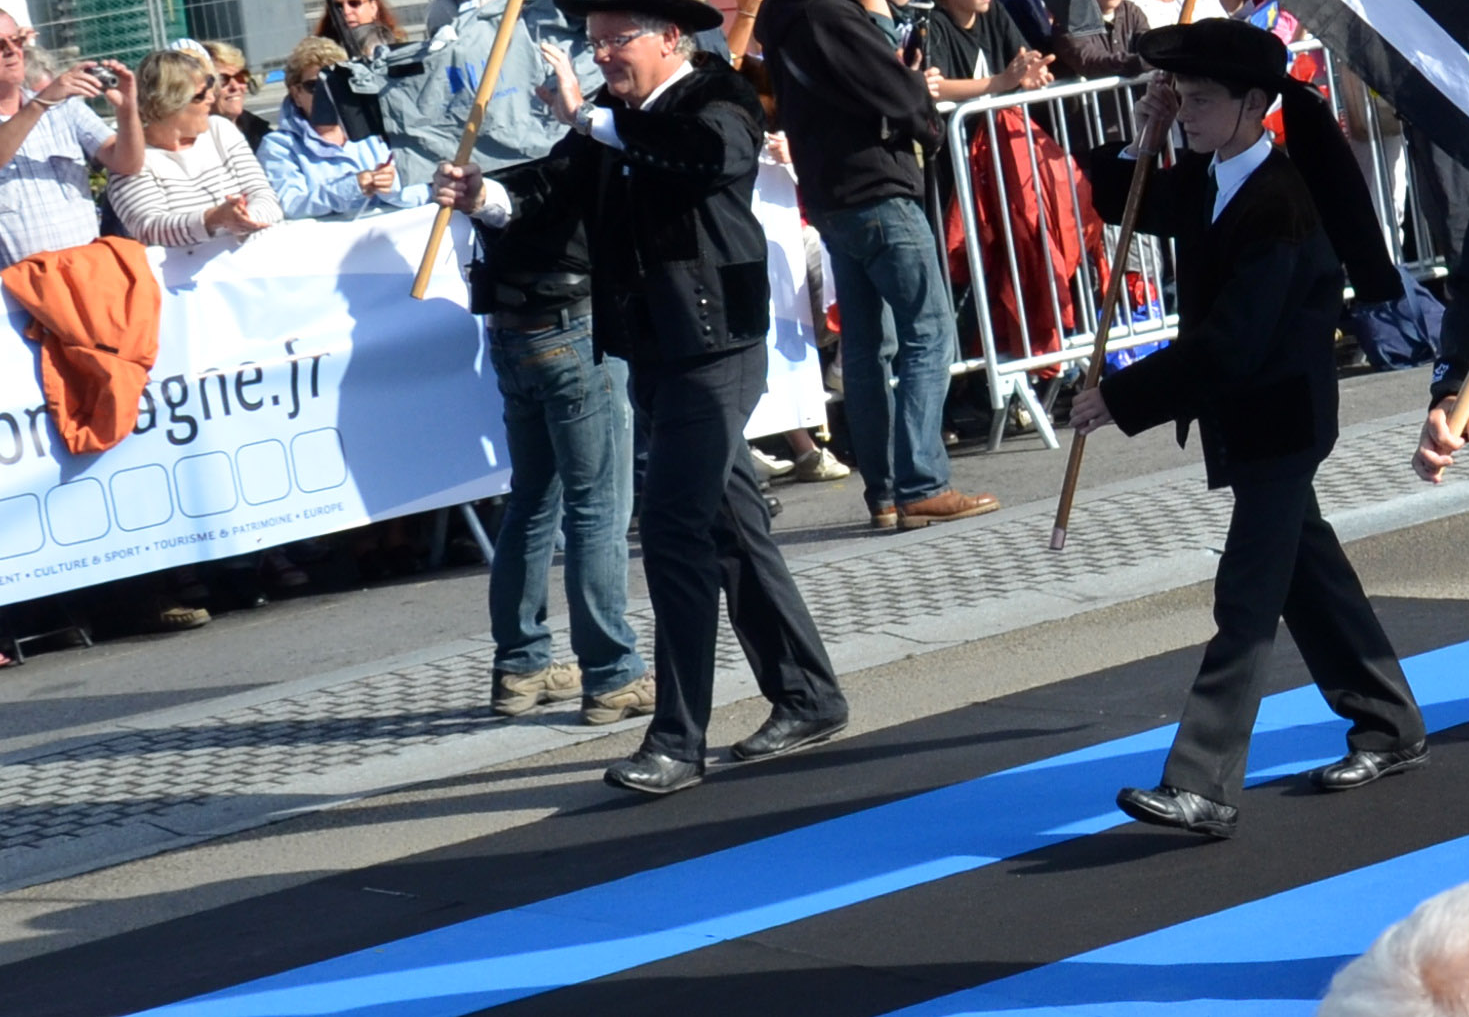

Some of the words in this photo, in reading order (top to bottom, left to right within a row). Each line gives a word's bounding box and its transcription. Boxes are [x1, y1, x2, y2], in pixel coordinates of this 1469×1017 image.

[34, 558, 89, 578] CULTURE
[92, 555, 101, 565] &
[104, 546, 141, 562] SPORT
[153, 531, 217, 551] TOURISME
[219, 529, 229, 539] &
[232, 512, 293, 535] PATRIMOINE
[303, 502, 345, 520] EUROPE
